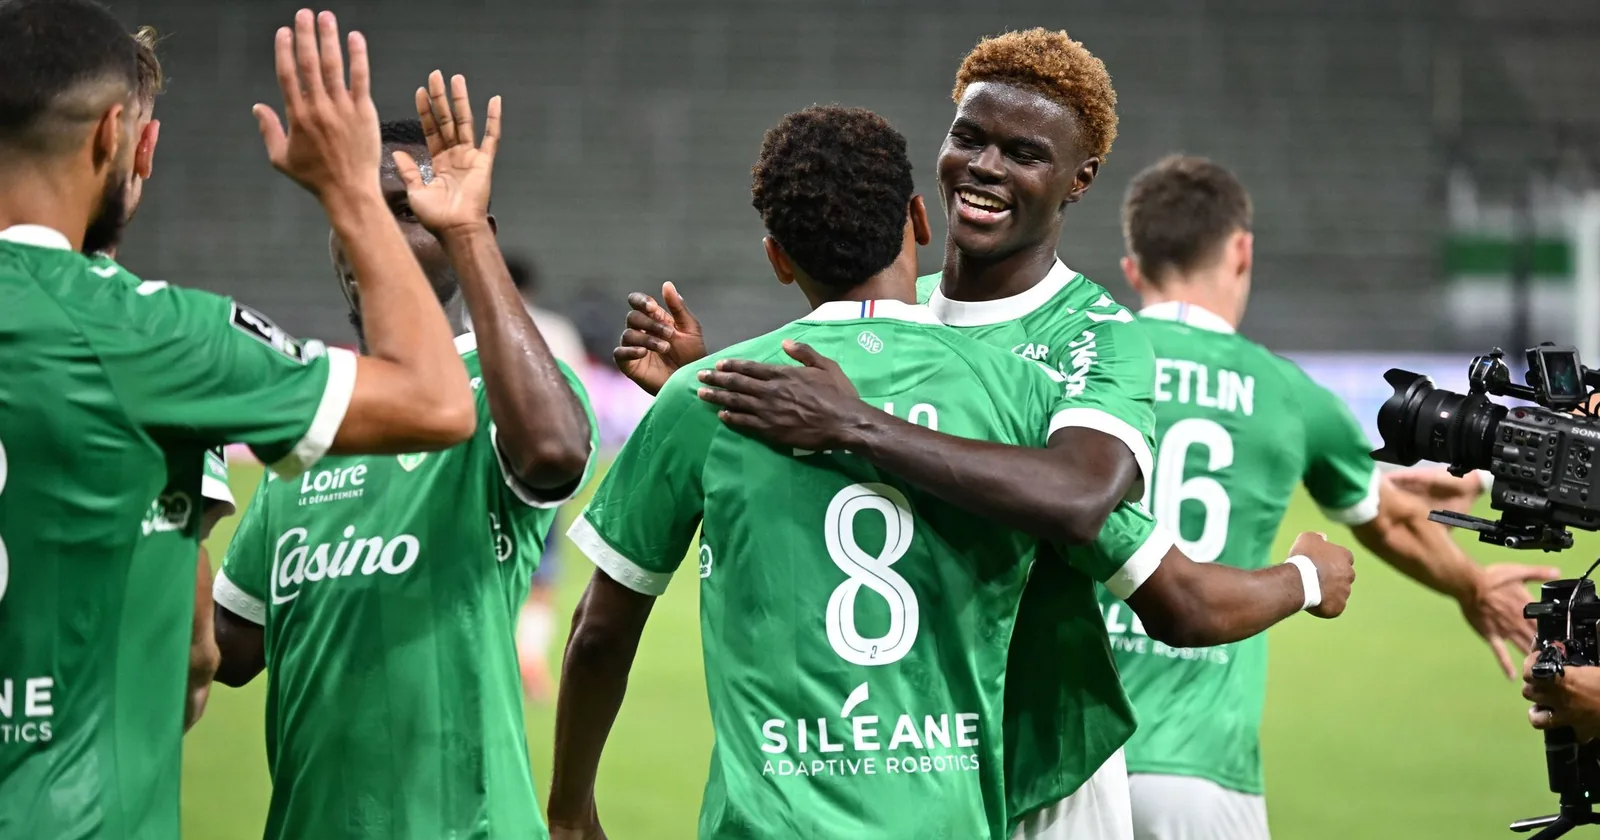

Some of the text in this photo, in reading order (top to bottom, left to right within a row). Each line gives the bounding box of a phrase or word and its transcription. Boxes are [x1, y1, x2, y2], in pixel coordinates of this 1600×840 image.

[859, 332, 881, 352] ASSE
[1155, 357, 1255, 417] ETLIN
[298, 488, 364, 506] LE DÉPARTEMENT
[1154, 417, 1234, 563] 6
[270, 525, 420, 605] Casino
[823, 482, 920, 667] 8
[1, 721, 53, 744] TICS
[761, 681, 979, 754] SILÉANE
[762, 753, 979, 777] ADAPTIVE ROBOTICS
